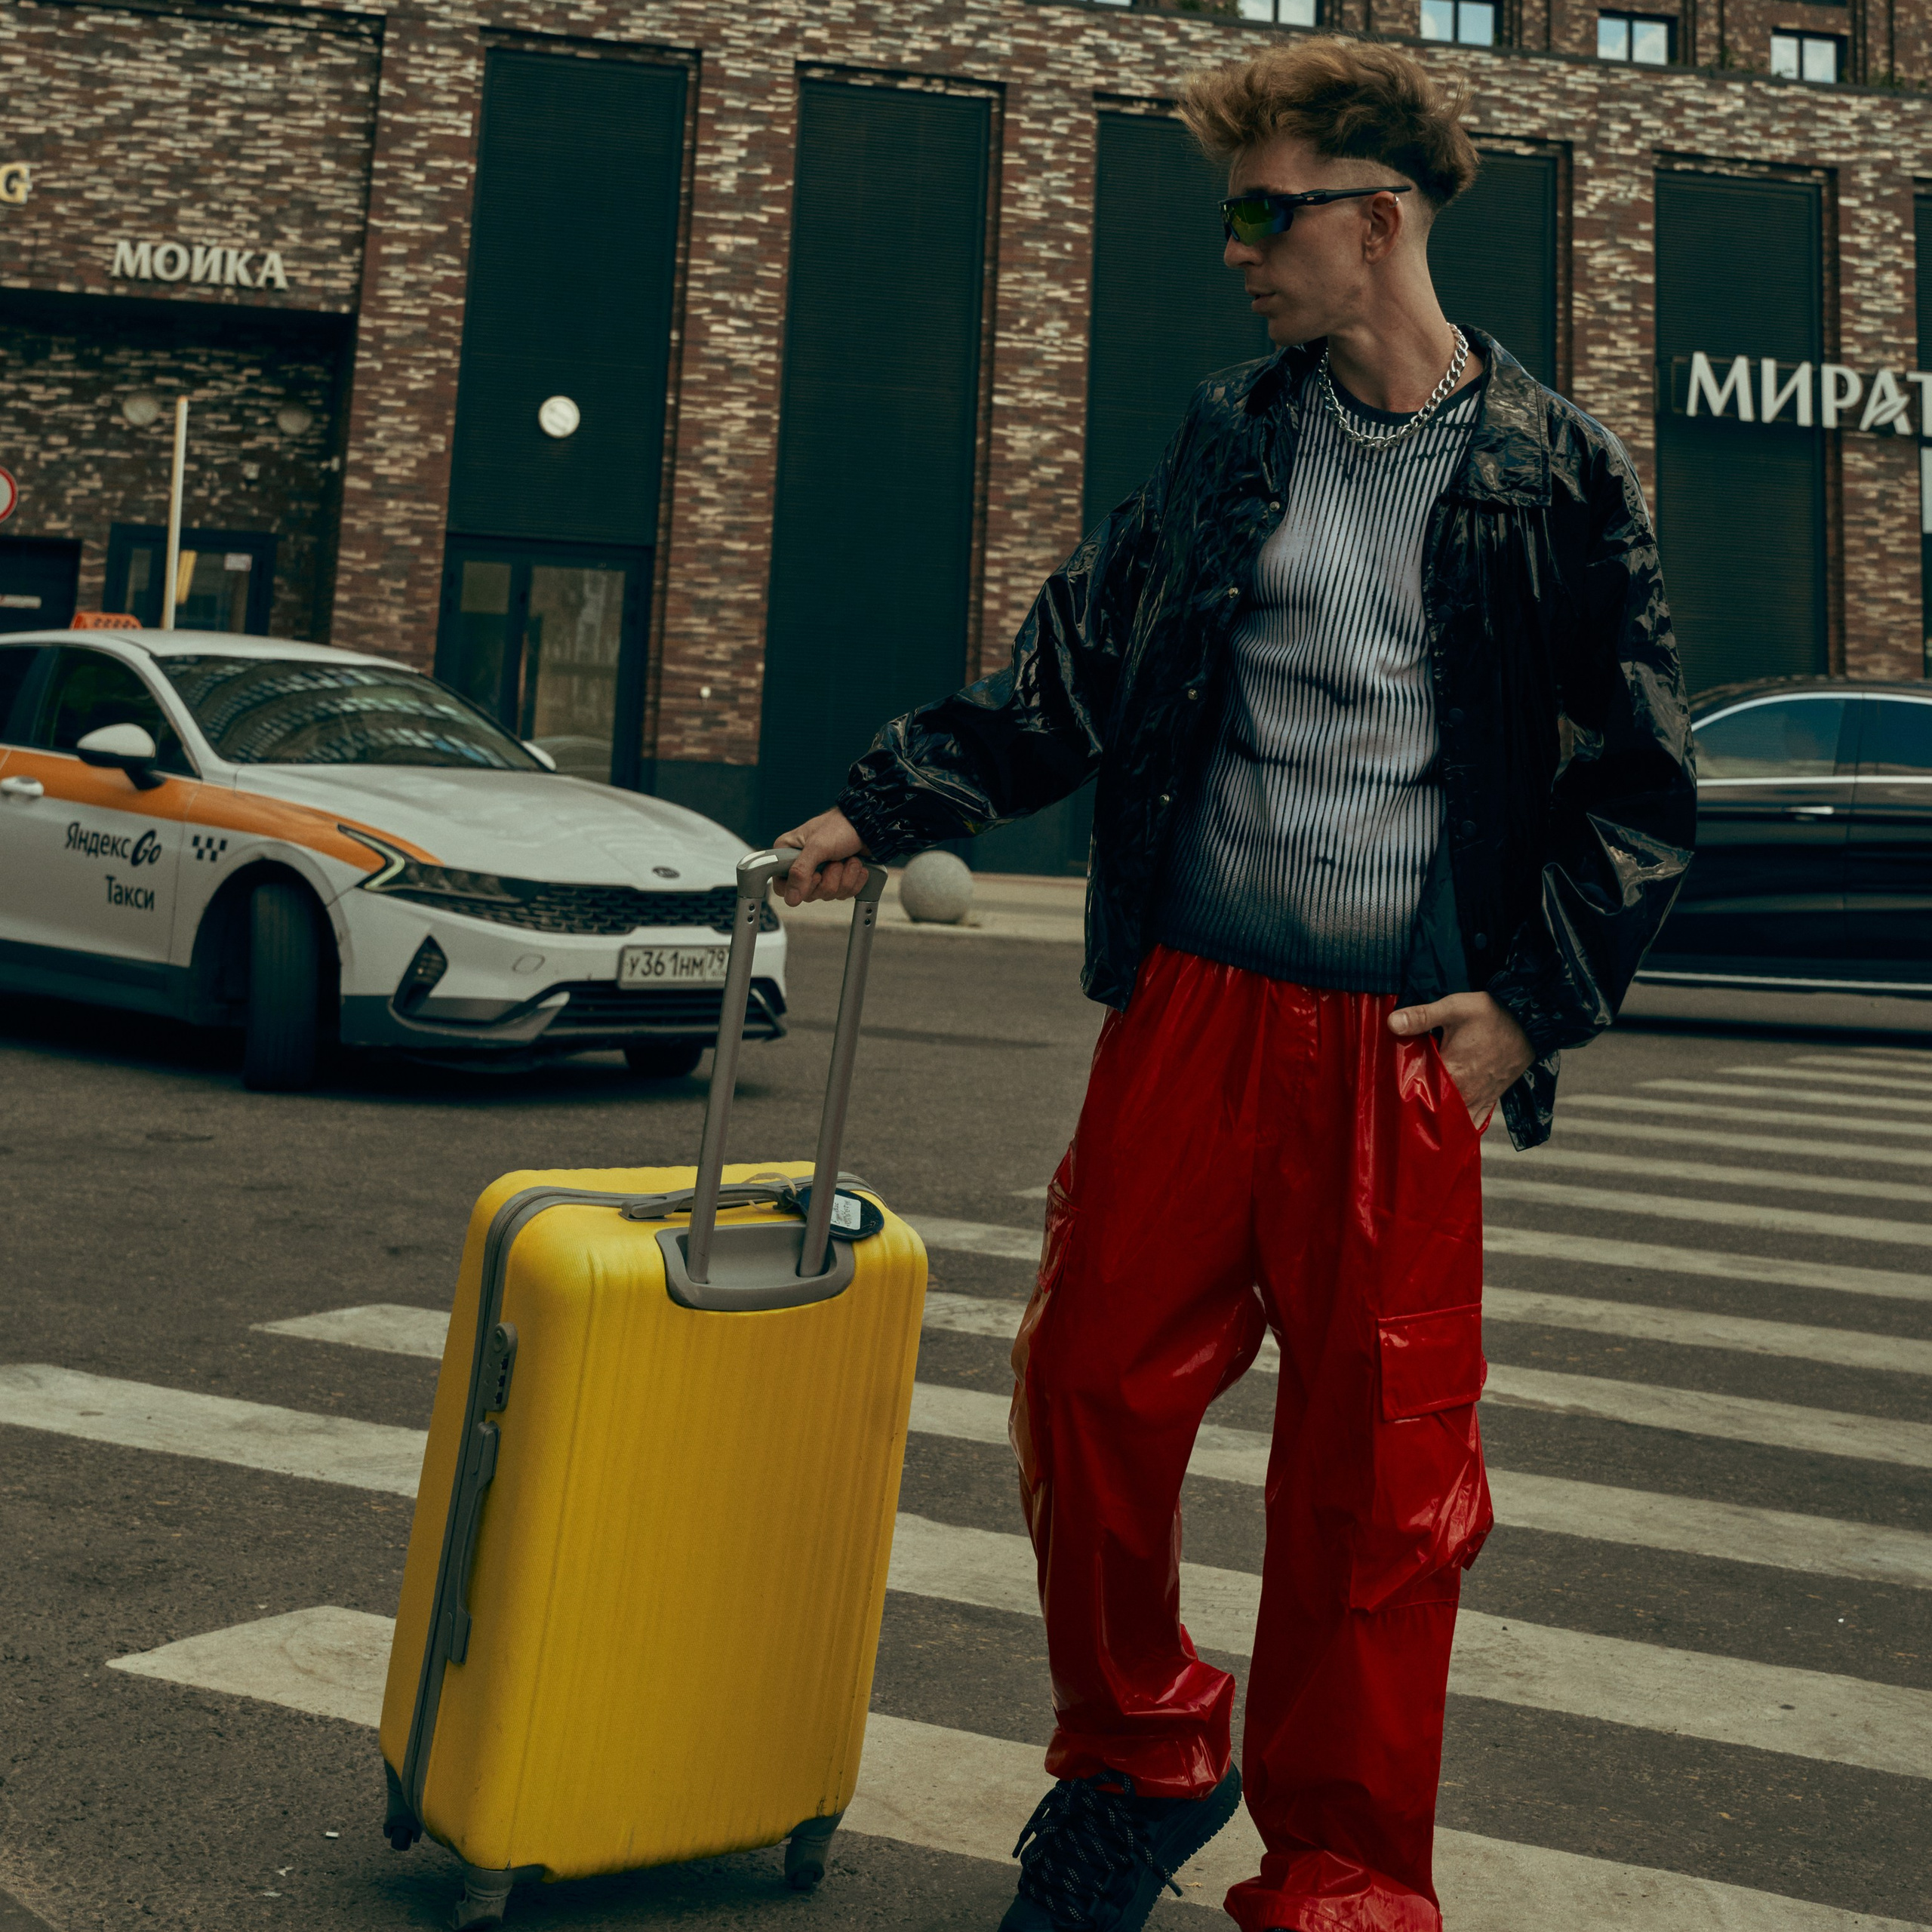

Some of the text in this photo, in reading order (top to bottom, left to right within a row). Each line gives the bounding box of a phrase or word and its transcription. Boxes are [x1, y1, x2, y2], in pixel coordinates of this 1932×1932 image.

[112, 237, 289, 290] МОЙКА
[66, 822, 162, 867] Яндекс Go
[105, 874, 155, 912] Такси
[707, 949, 730, 970] 79
